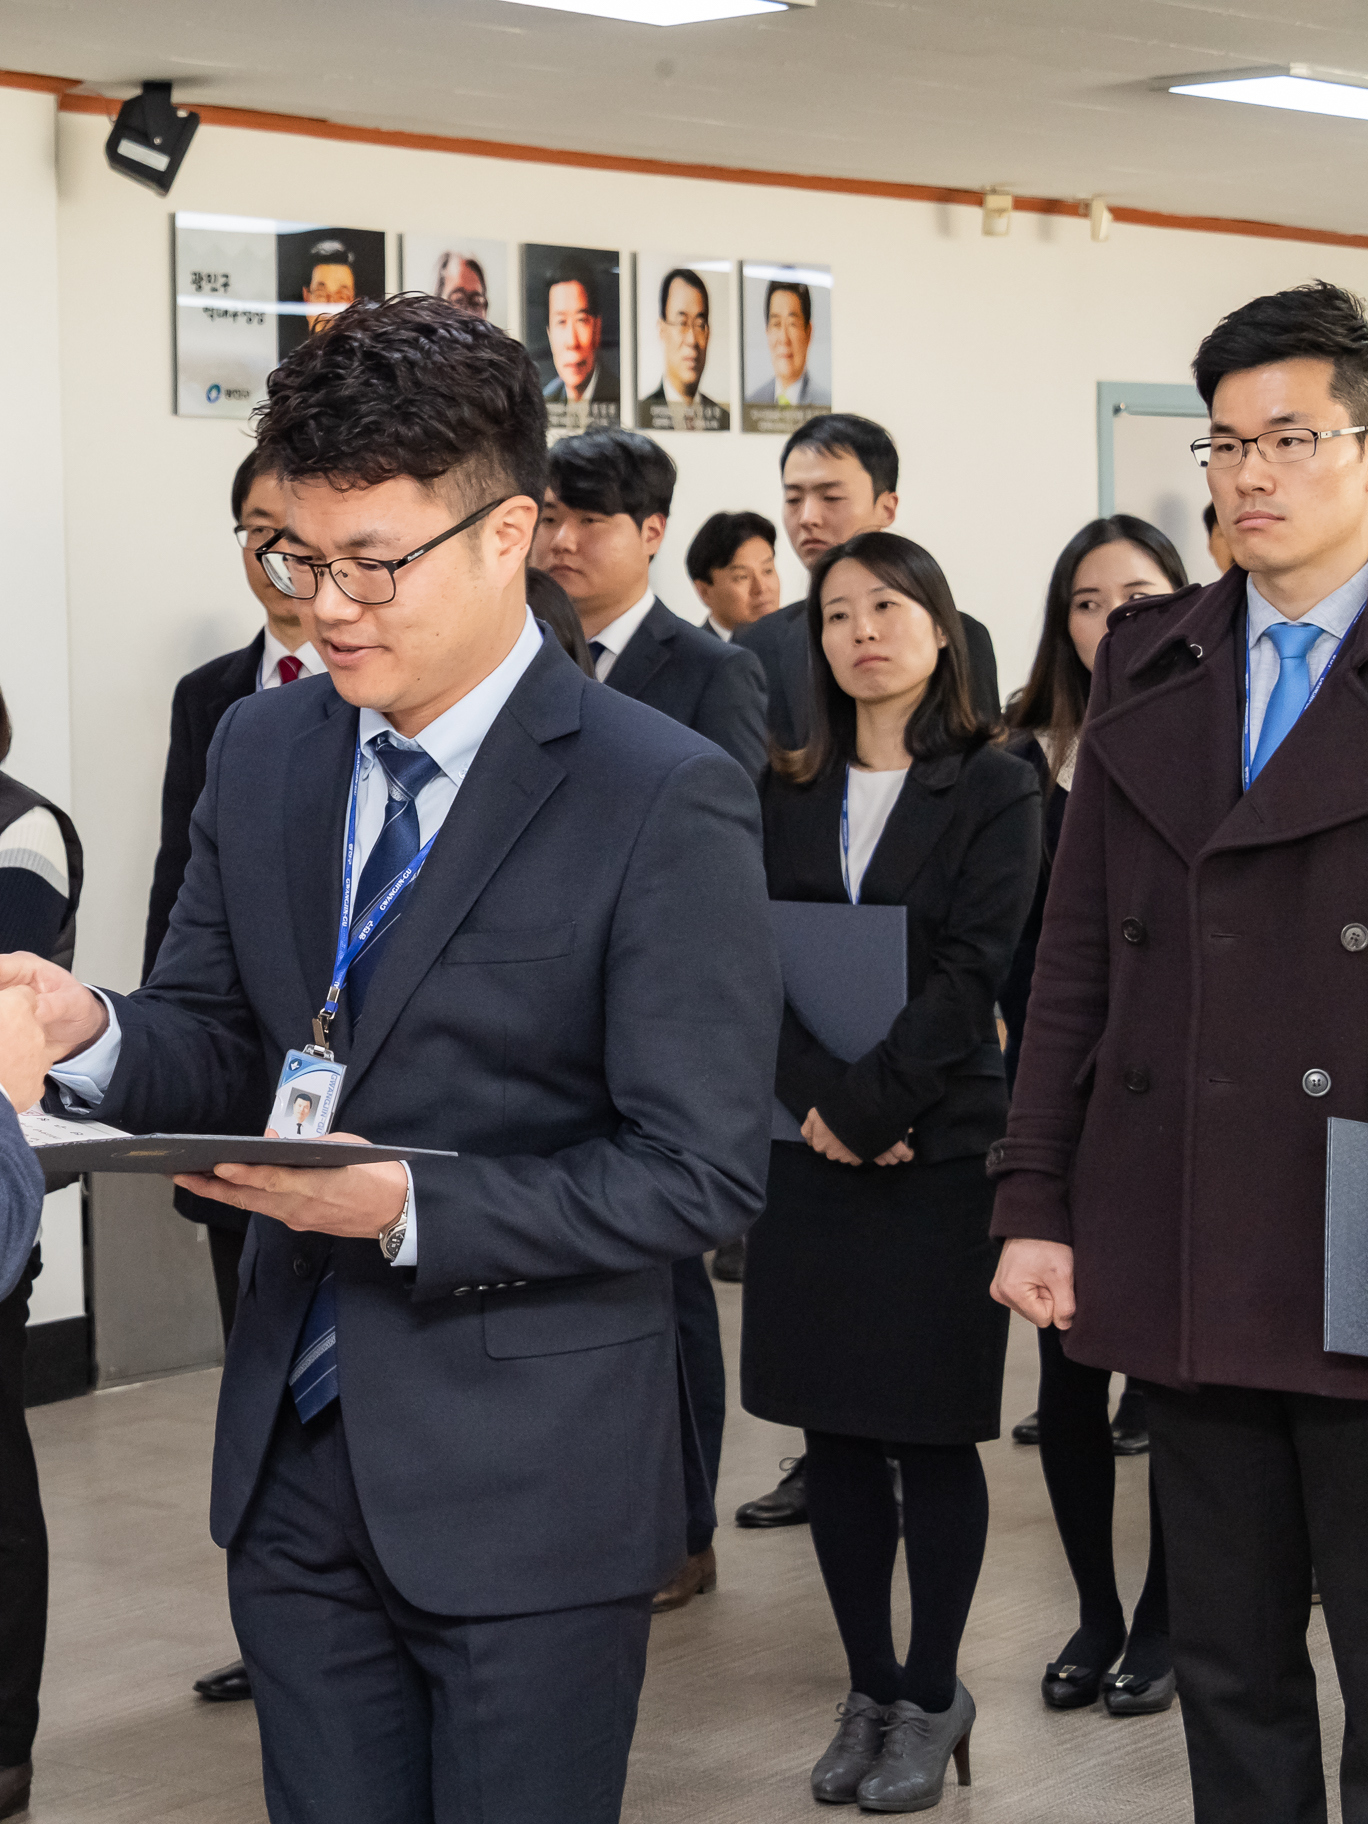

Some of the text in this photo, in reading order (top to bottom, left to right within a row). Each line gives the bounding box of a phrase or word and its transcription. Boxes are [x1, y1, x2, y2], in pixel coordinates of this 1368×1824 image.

[190, 271, 230, 294] 광진구
[341, 878, 351, 927] GWANGJIN-GU
[379, 868, 412, 911] GWANGJIN-GU
[358, 920, 373, 940] 광진구
[316, 1074, 338, 1136] GWANGJIN-GU
